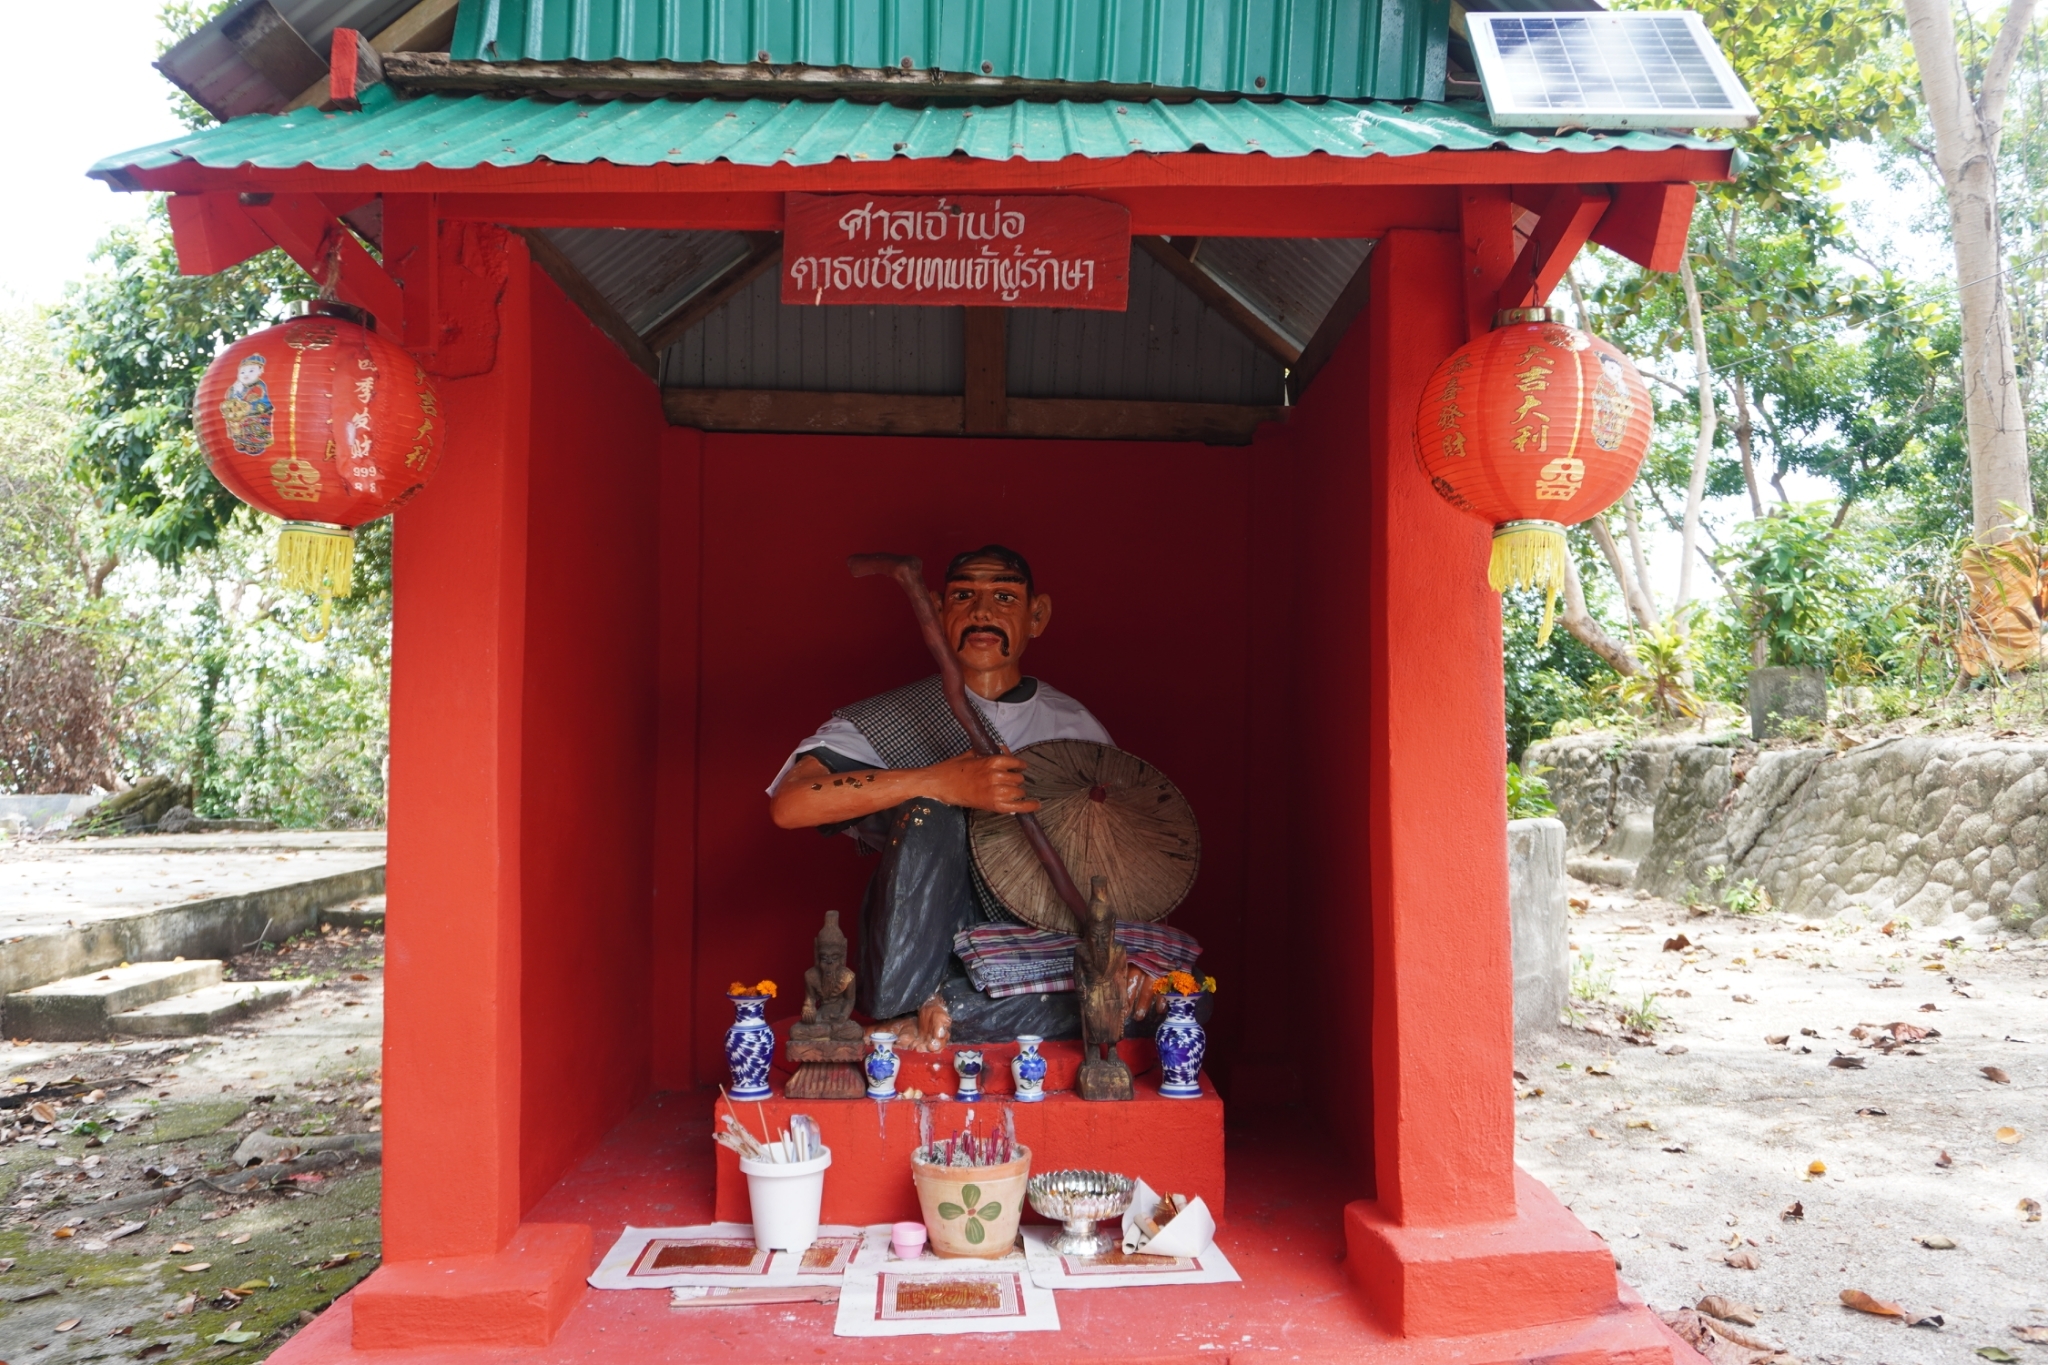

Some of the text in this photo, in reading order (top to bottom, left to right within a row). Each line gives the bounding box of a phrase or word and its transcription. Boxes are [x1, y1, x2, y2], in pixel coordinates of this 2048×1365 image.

[838, 197, 1026, 241] ศาลเจ้าพ่อ
[404, 366, 438, 472] 大吉大利
[1510, 345, 1554, 453] 大吉大利
[352, 465, 377, 478] 999
